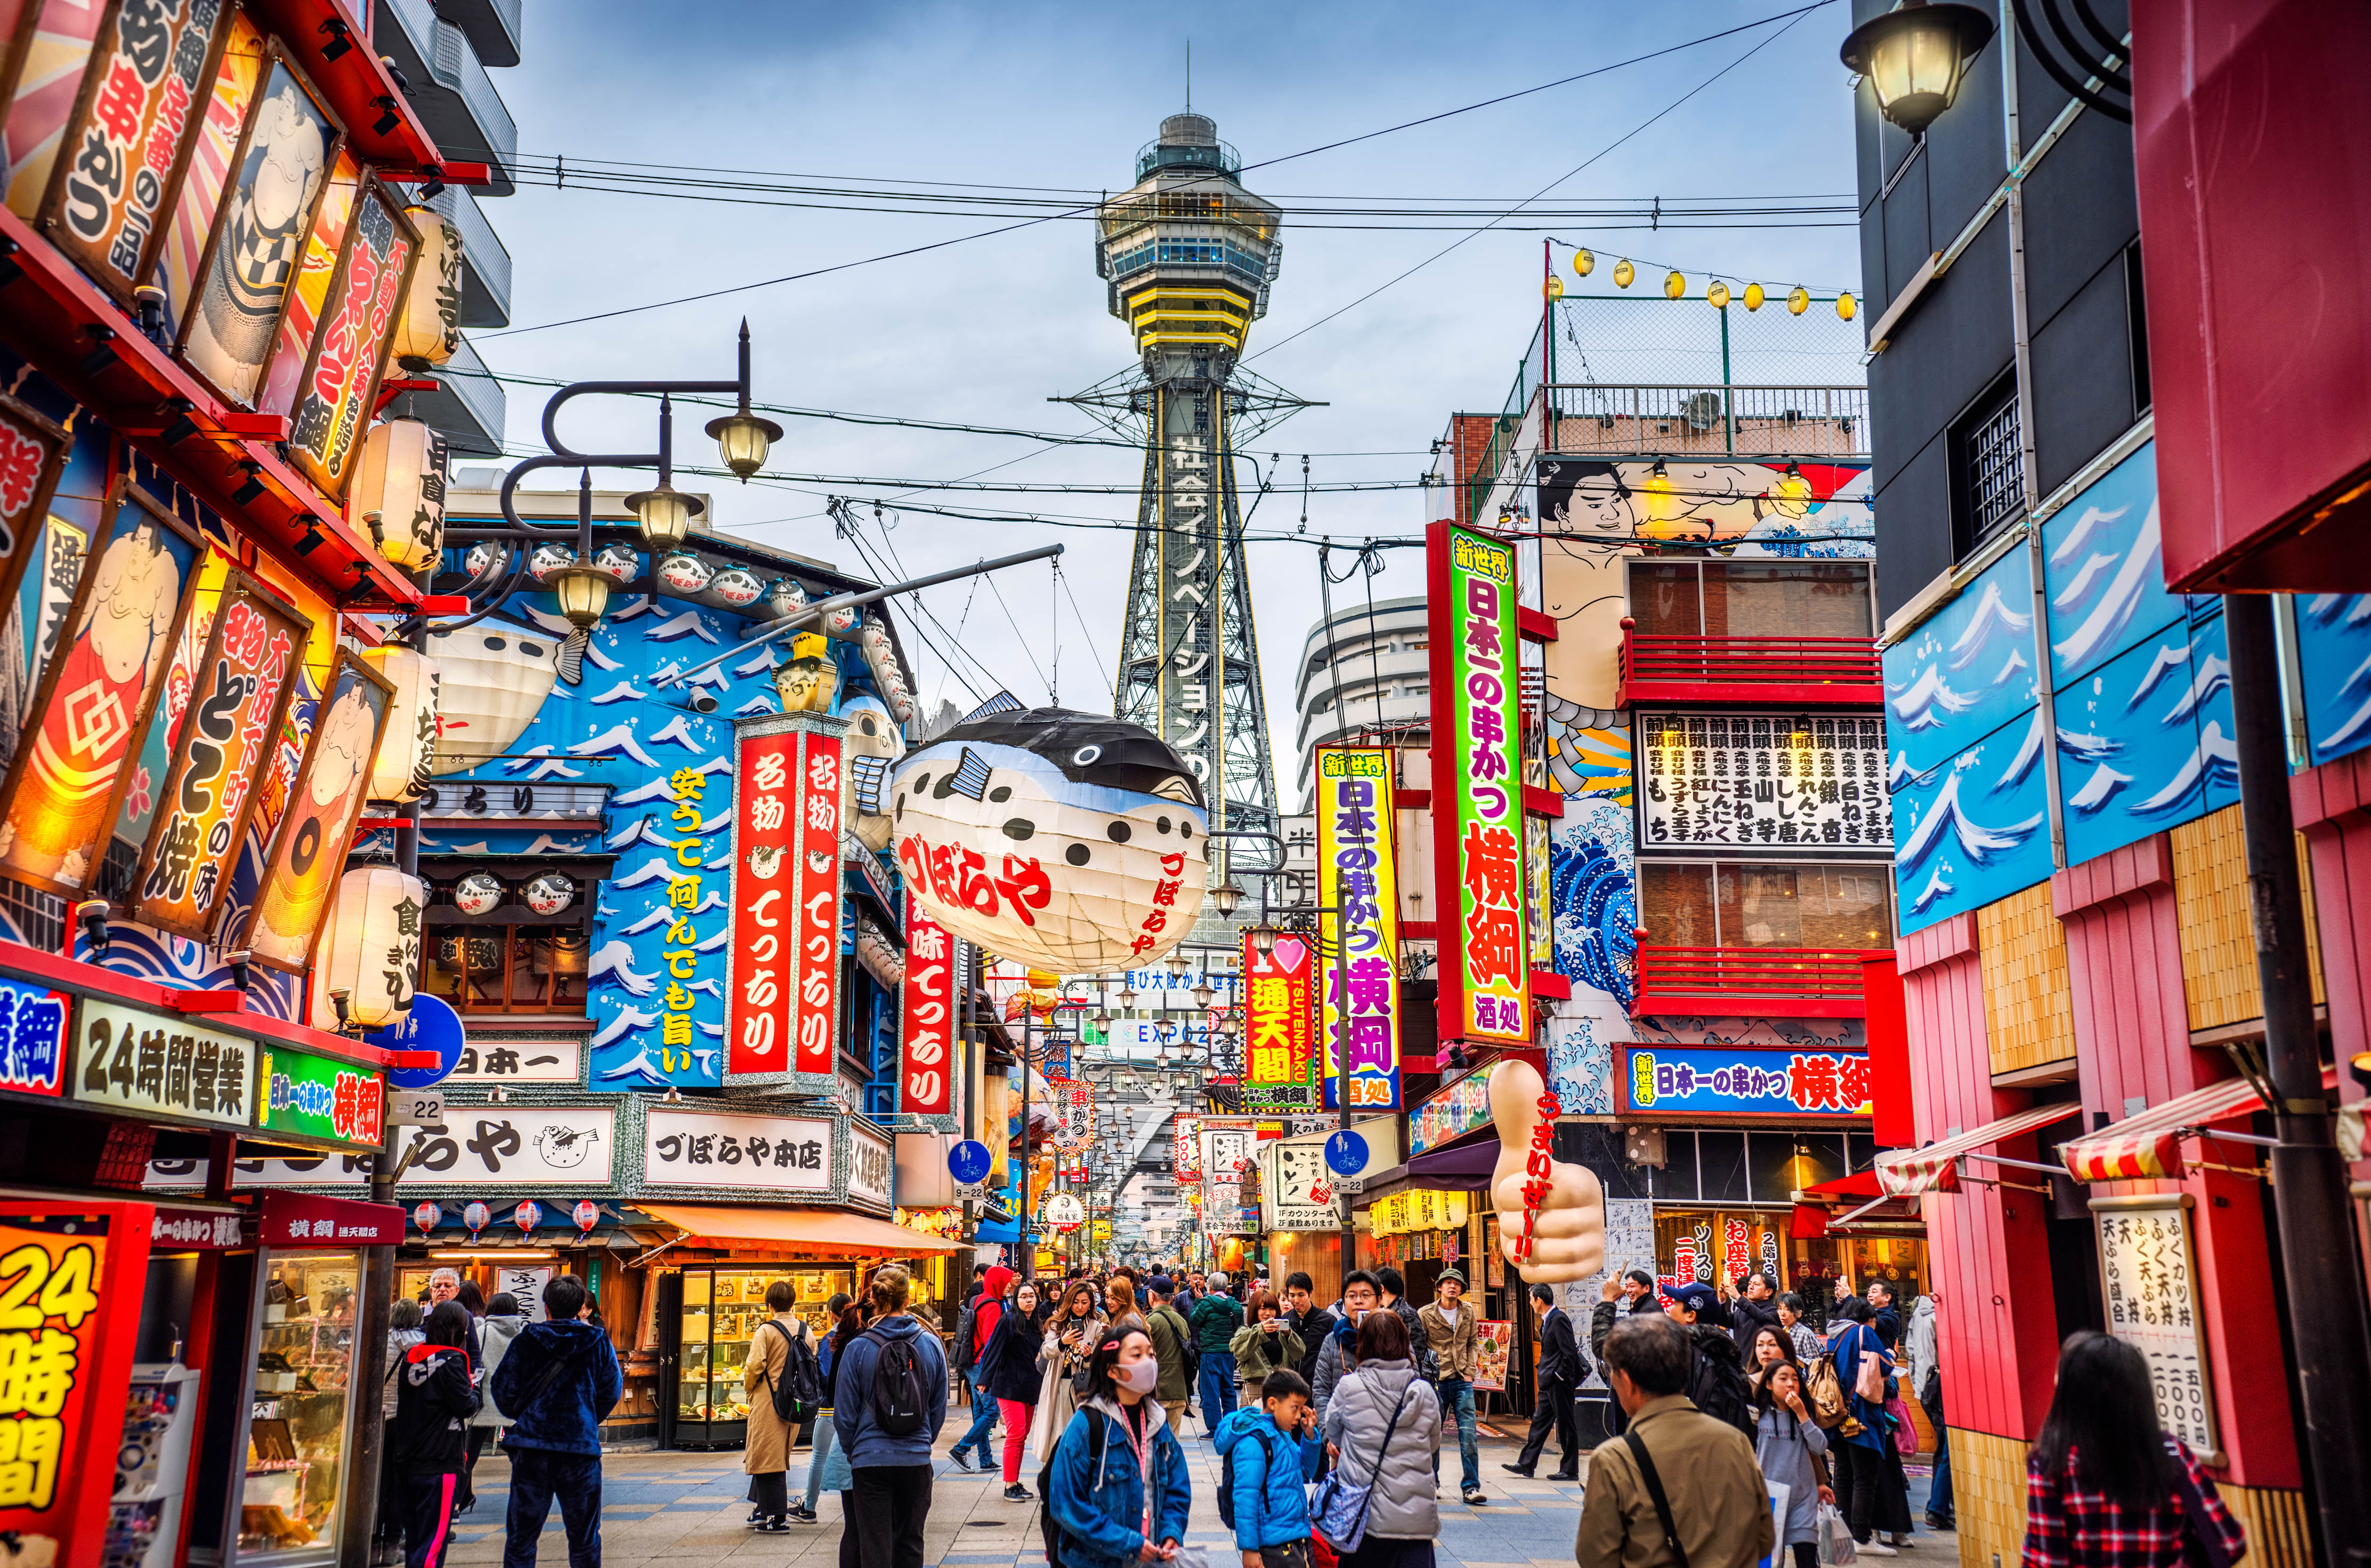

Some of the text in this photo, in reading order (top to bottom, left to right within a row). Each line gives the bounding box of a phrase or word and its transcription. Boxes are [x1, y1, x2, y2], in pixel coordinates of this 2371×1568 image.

[1455, 538, 1509, 581] 新世界
[194, 630, 291, 913] 大阪下町の味
[1325, 754, 1385, 777] 新世界
[743, 753, 785, 1055] 名物 てっちり
[801, 753, 836, 1055] 名物 てっちり
[899, 833, 1051, 926] づぼらや
[1130, 851, 1187, 955] づぼらや
[662, 767, 706, 1073] 安うて何んでも旨い
[1252, 978, 1290, 1083] 通天閣
[1293, 979, 1308, 1082] TSUTENKAKU
[1476, 996, 1520, 1033] 酒処
[85, 1018, 245, 1116] 24時間営業
[1636, 1055, 1654, 1104] 新世界
[1657, 1066, 1786, 1096] 日本一の串かつ
[333, 1072, 381, 1142] 横綱
[1070, 1089, 1087, 1135] 串かつ
[657, 1133, 822, 1170] づぼらや本店
[289, 1220, 377, 1238] 横綱 通天閣店
[1695, 1226, 1711, 1278] ソースの
